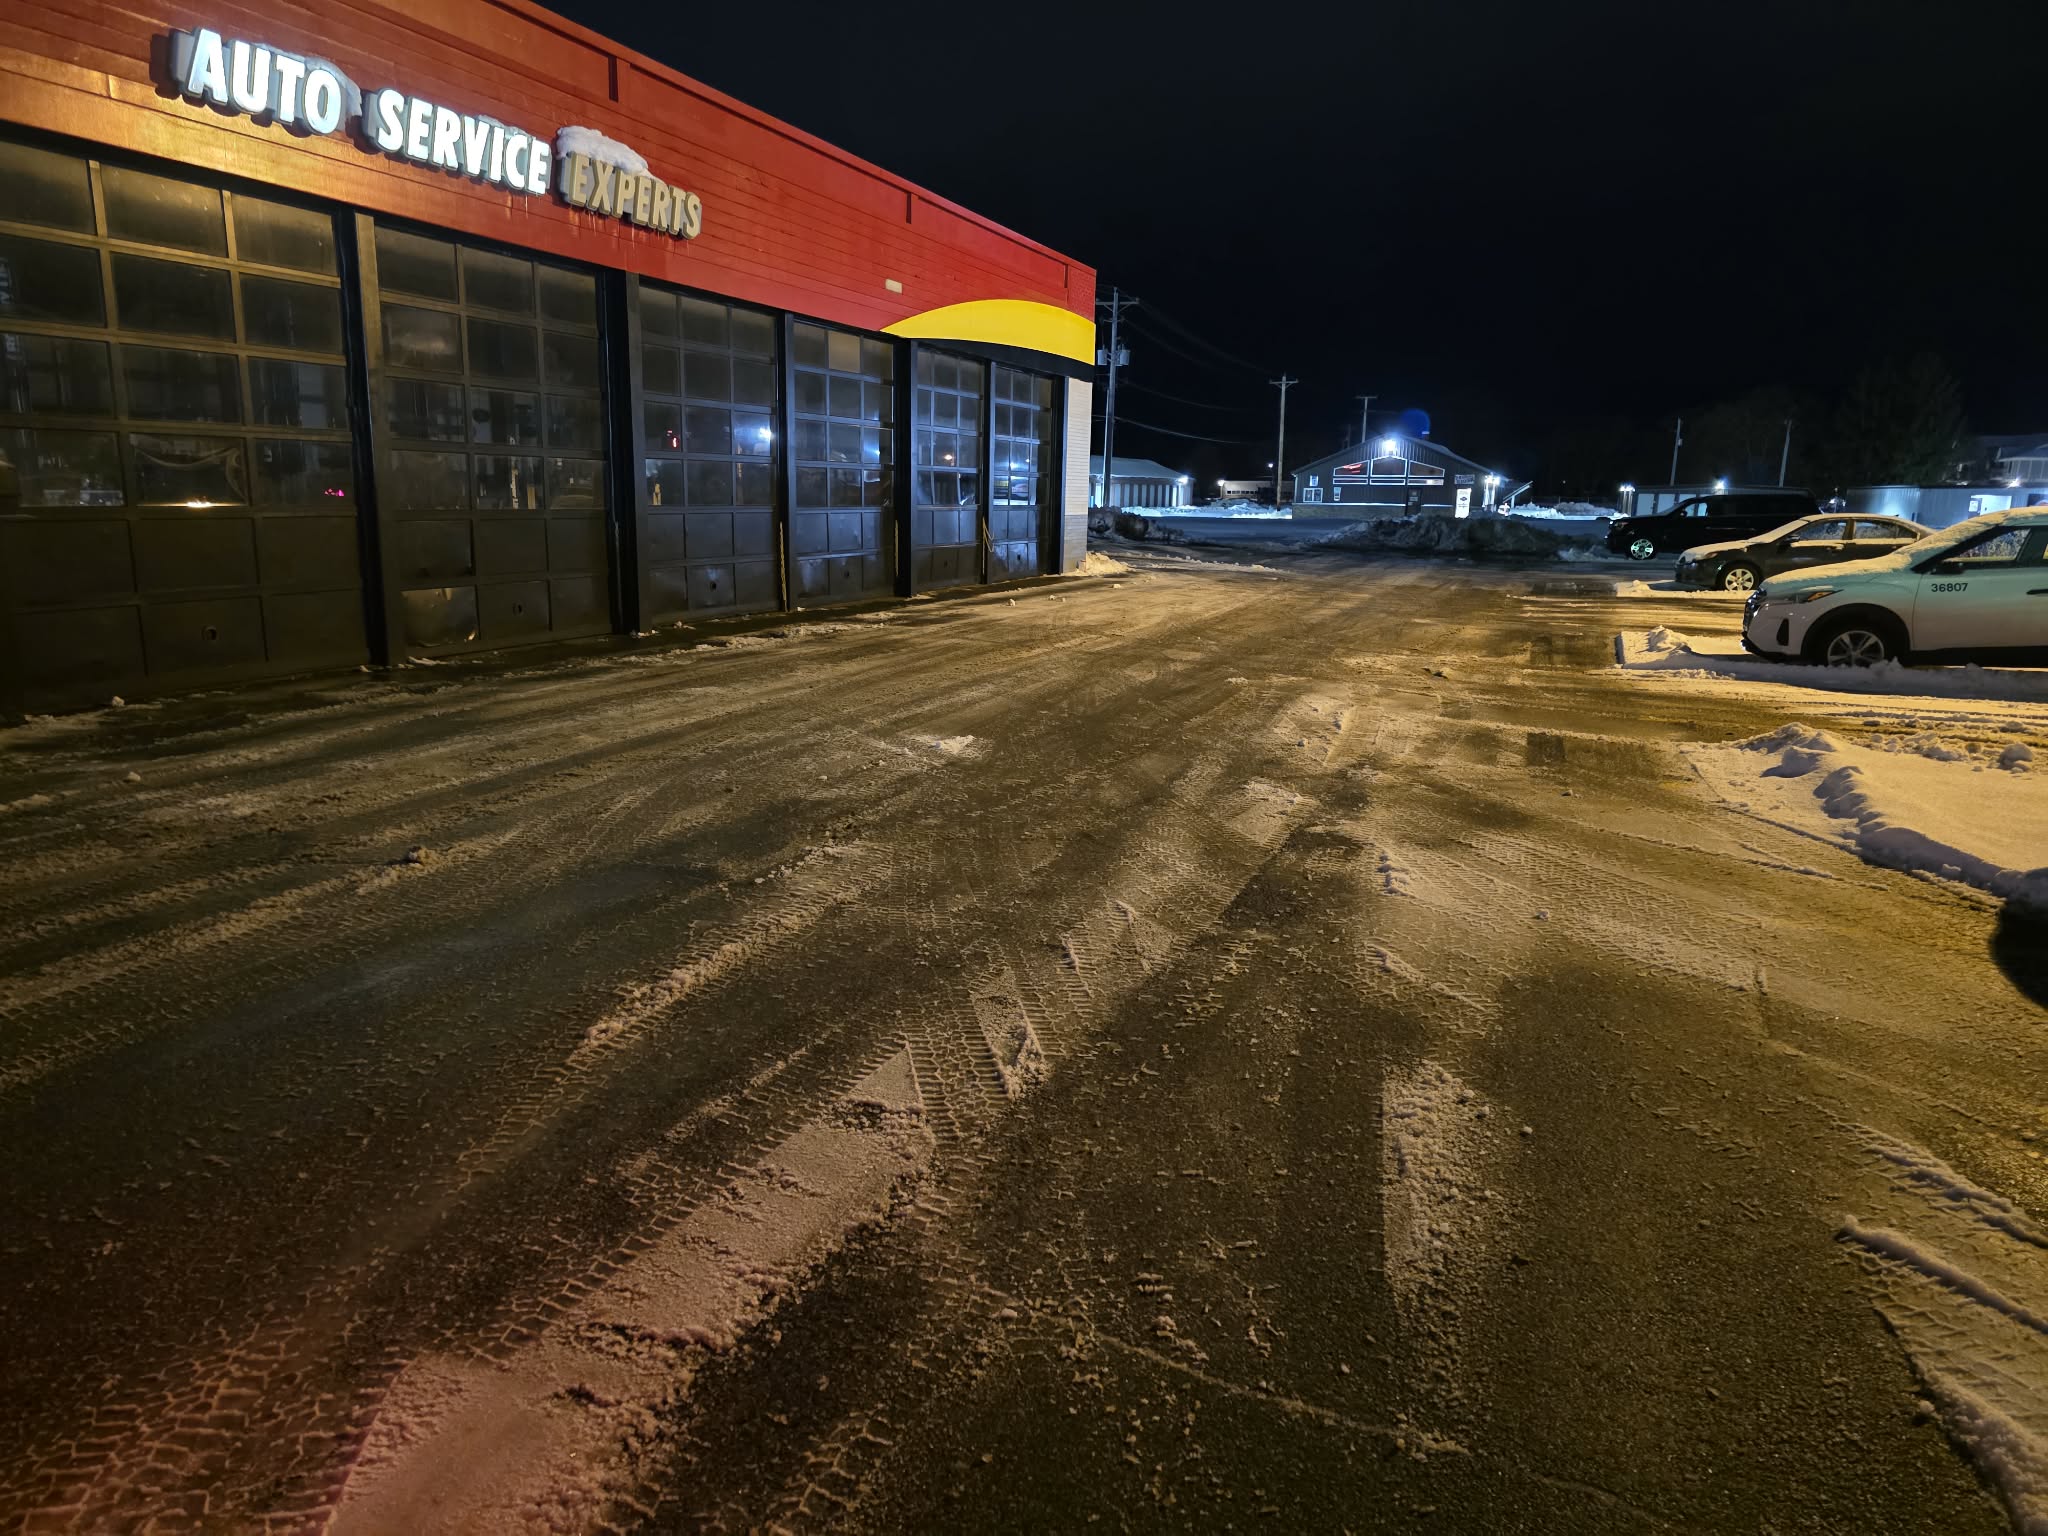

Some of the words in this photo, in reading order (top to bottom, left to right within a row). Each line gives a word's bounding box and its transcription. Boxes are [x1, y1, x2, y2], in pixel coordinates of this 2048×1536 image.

[187, 28, 342, 135] AUTO
[377, 88, 551, 196] SERVICE
[570, 152, 702, 240] EXPERTS
[1930, 582, 1969, 593] 36807
